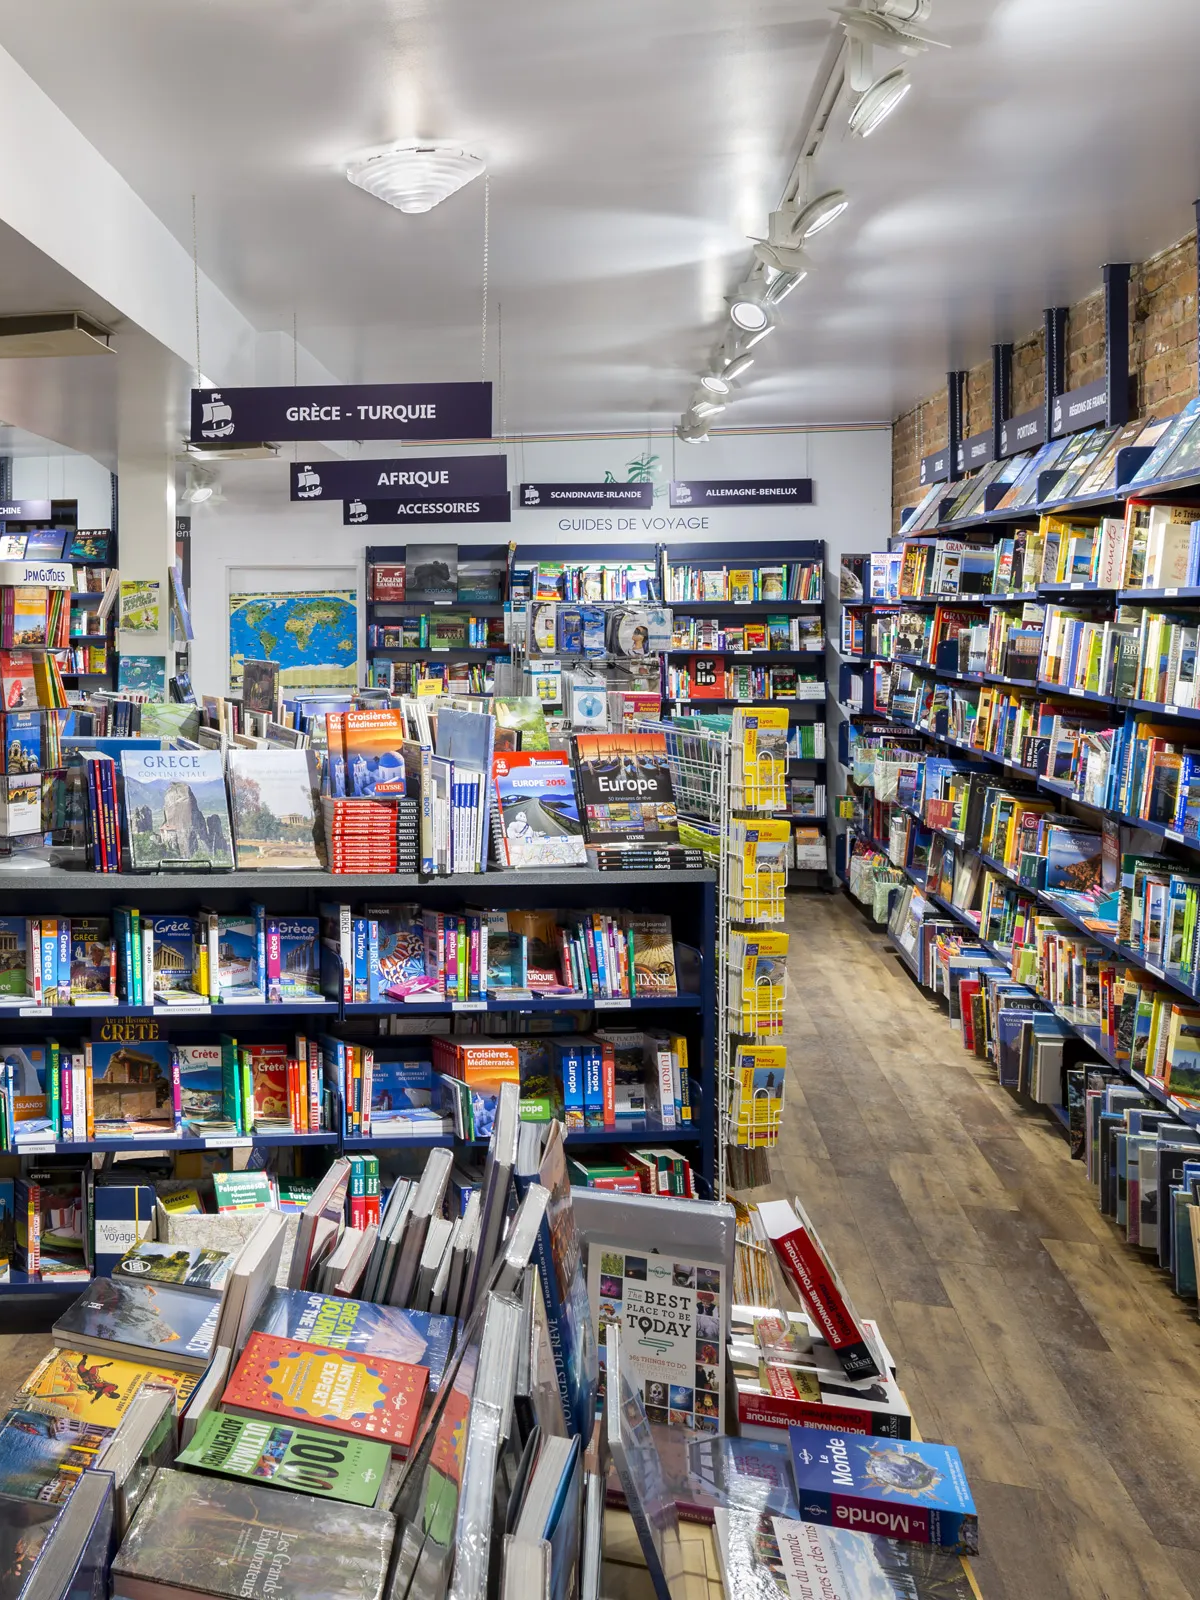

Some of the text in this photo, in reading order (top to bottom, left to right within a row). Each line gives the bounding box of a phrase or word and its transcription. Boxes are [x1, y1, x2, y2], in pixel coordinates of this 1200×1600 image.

[286, 402, 341, 422] GRÈCE
[357, 404, 437, 424] TURQUIE
[1086, 398, 1092, 411] DE
[1017, 422, 1038, 440] PORTUGAL
[377, 470, 449, 487] AFRIQUE
[550, 490, 642, 499] SCANDINAVIE-IRLANDE
[706, 487, 797, 497] ALLEMAGNE-BENELUX
[397, 502, 480, 514] ACCESSOIRES
[558, 517, 709, 531] GUIDES DE VOYAGE
[376, 572, 404, 581] ENGLISH
[697, 660, 713, 670] er
[697, 671, 716, 683] lin
[739, 666, 749, 698] BERLIN
[347, 712, 391, 722] Croisières
[347, 720, 397, 729] Méditerranée
[143, 756, 201, 768] GRECE
[138, 770, 207, 778] CONTINENTALE
[598, 776, 658, 794] Europe
[155, 919, 190, 933] Grèce
[278, 921, 315, 934] Grèce
[341, 908, 350, 935] TURKEY
[73, 932, 98, 941] GRÈCE
[60, 934, 68, 962] Greece
[270, 935, 278, 960] Grèce
[356, 932, 366, 960] Turkey
[44, 942, 54, 981] Greece
[371, 941, 380, 975] TURKEY
[100, 1022, 159, 1042] CRETE
[192, 1048, 218, 1059] Crète
[467, 1050, 508, 1059] Croisières
[467, 1058, 515, 1066] Méditerranée
[257, 1062, 285, 1072] Crète
[592, 1059, 600, 1091] Europe
[660, 1054, 672, 1094] EUROPE
[568, 1060, 577, 1094] Europe
[164, 1193, 190, 1204] GREECE
[100, 1224, 117, 1234] Mes
[104, 1232, 141, 1243] voyages
[784, 1240, 812, 1290] TOURISTIQUE
[626, 1289, 691, 1310] The BEST
[626, 1303, 691, 1321] PLACE TO BE
[810, 1289, 841, 1344] DICTIONNAIRE
[626, 1313, 692, 1338] TODAY
[642, 1357, 663, 1366] THINGS
[843, 1357, 874, 1374] ULYSSE
[548, 1317, 572, 1427] VOYAGES DE RÊVE
[312, 1362, 338, 1408] EXPERT
[328, 1363, 356, 1413] INSTANT
[746, 1412, 866, 1436] DICTIONNAIRE TOURISTIQUE
[198, 1417, 244, 1466] ADVENTURES
[222, 1422, 271, 1474] ULTIMATE
[277, 1432, 349, 1490] 1000
[820, 1453, 829, 1464] Le
[831, 1438, 854, 1486] Monde
[836, 1505, 910, 1534] Monde
[913, 1520, 925, 1530] Le
[783, 1533, 808, 1584] du monde
[804, 1524, 827, 1578] et des vins
[240, 1528, 276, 1600] Explorateurs
[263, 1532, 298, 1593] Les Grands
